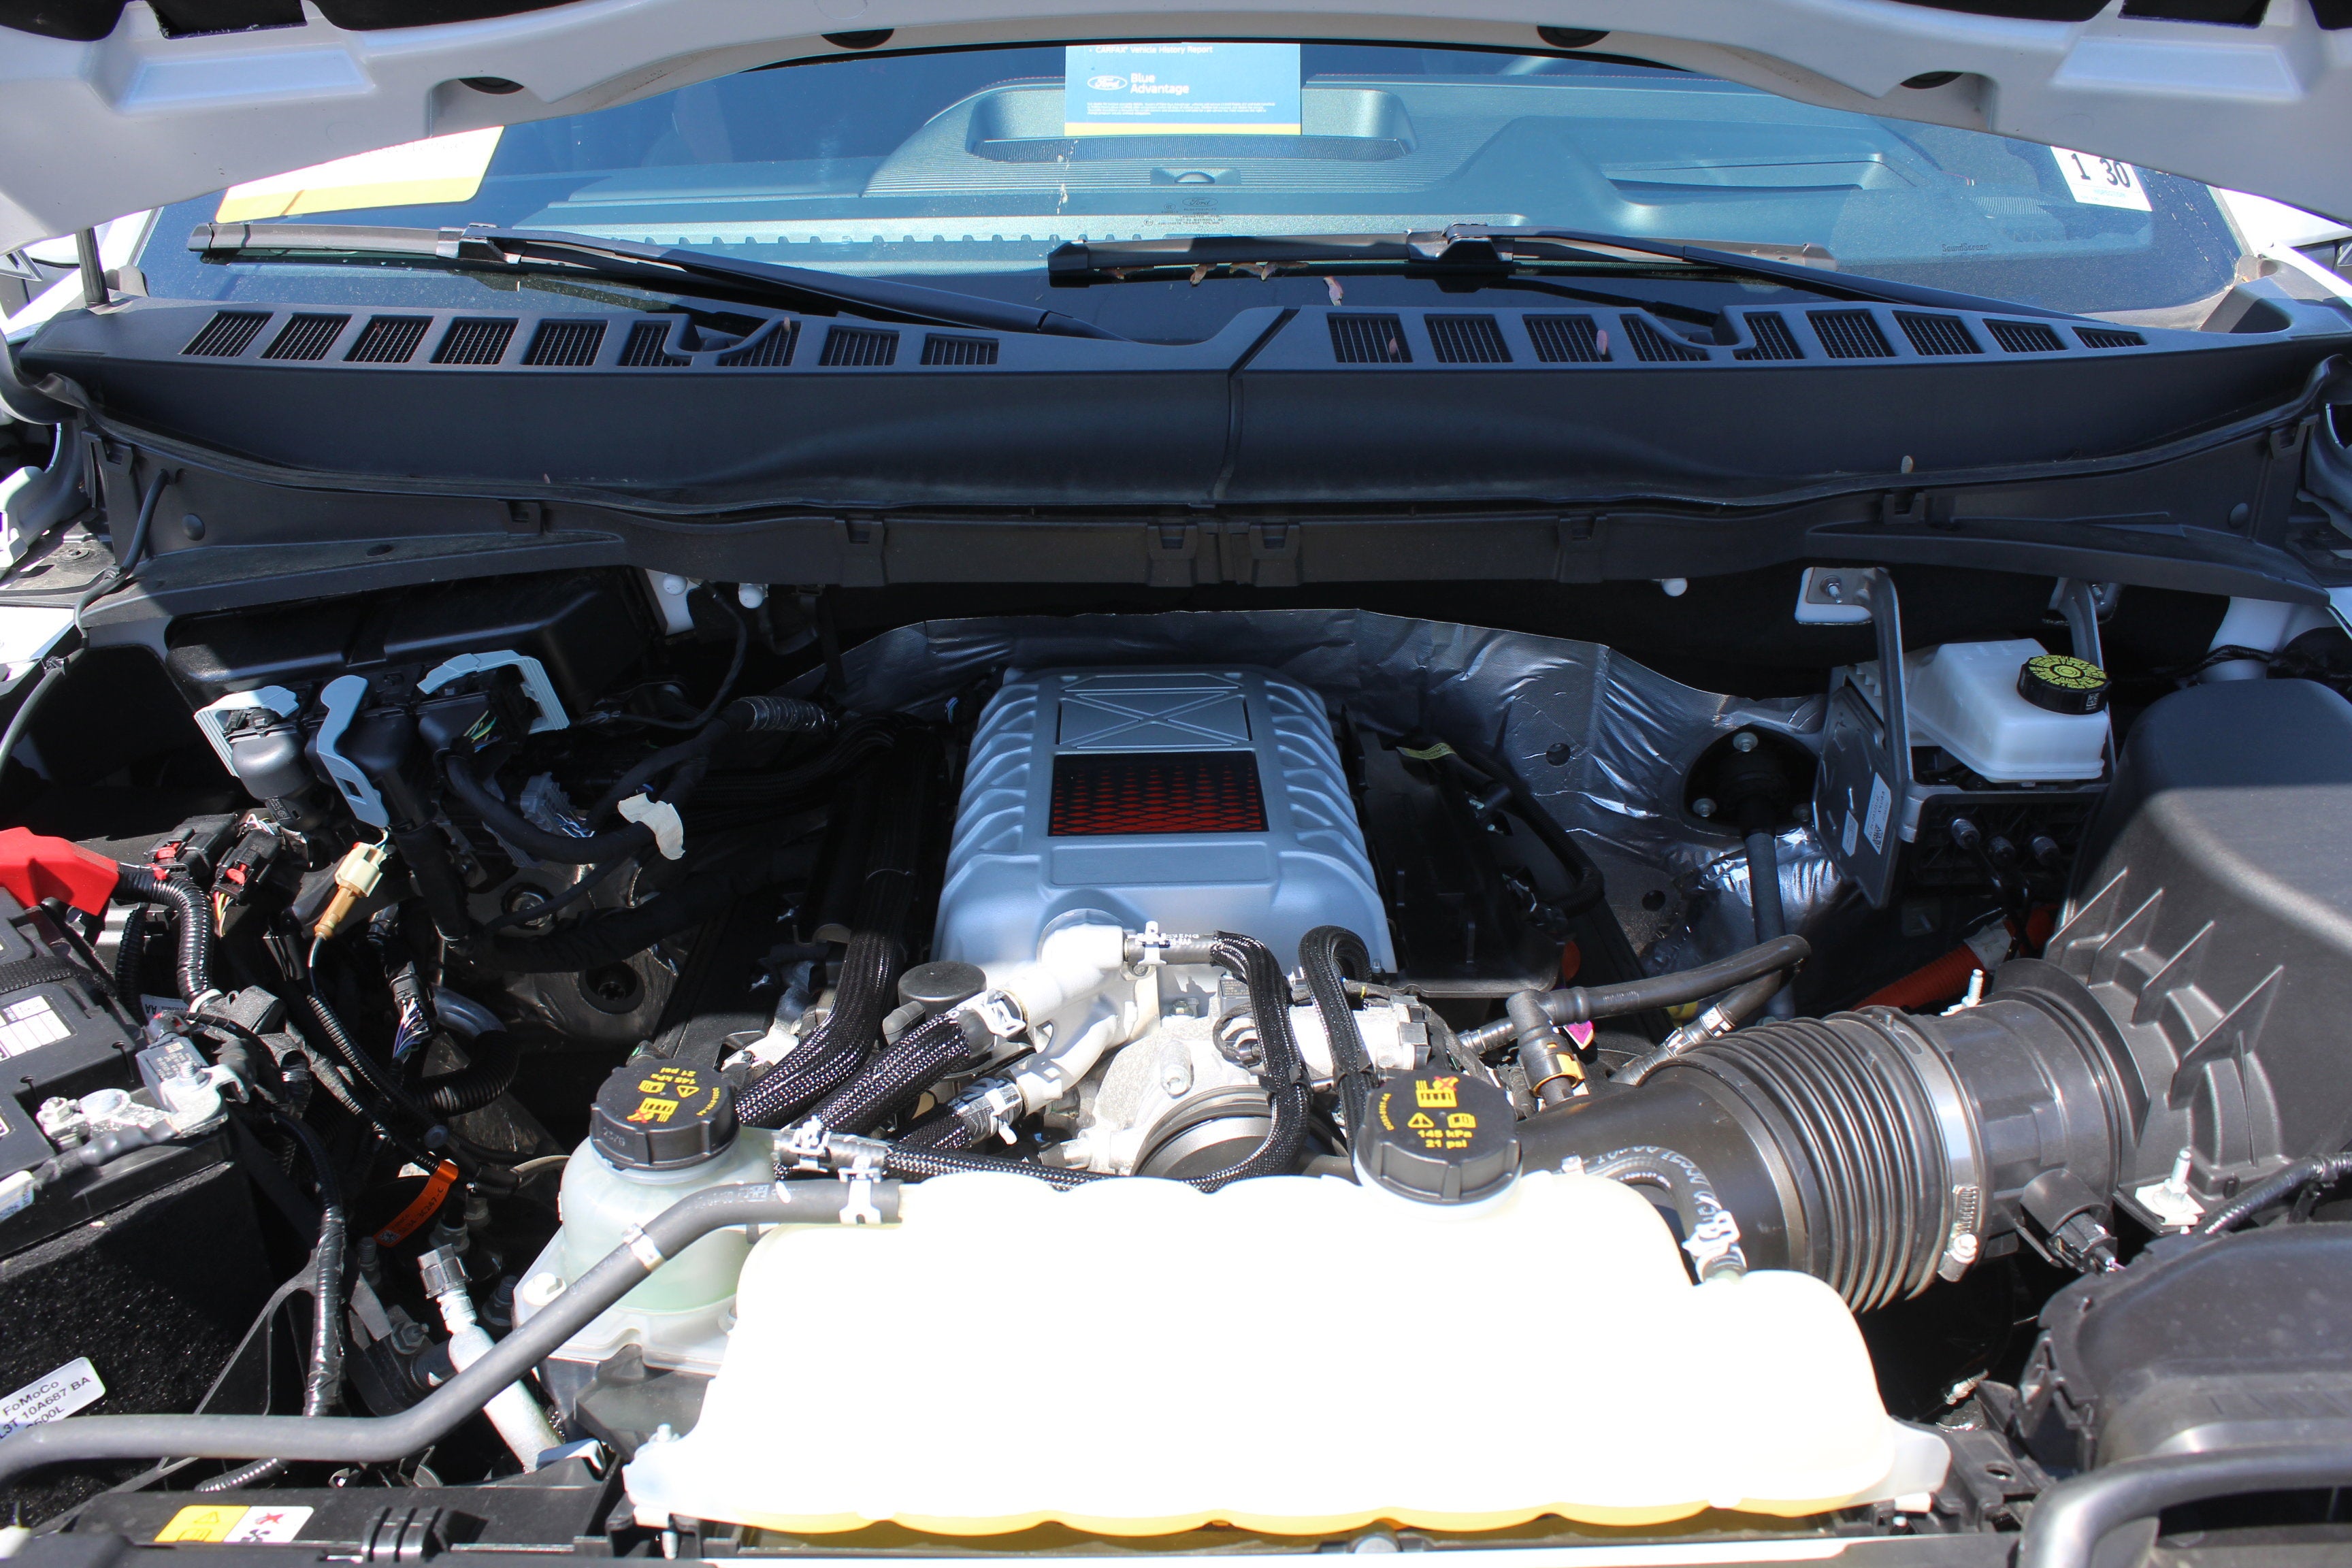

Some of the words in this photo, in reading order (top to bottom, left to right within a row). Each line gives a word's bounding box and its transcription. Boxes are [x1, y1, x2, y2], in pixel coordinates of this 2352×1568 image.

[1130, 46, 1156, 54] Vehicle
[1159, 46, 1185, 54] History
[1187, 46, 1213, 54] Report
[1130, 73, 1155, 83] Blue
[1130, 84, 1190, 95] Advantage
[2071, 153, 2091, 180] 1
[2100, 158, 2131, 189] 30
[1942, 242, 1988, 252] SoundScreen
[145, 1004, 157, 1015] AA
[650, 1073, 673, 1082] kPa
[1418, 1130, 1443, 1138] 145
[1446, 1130, 1473, 1138] kPa
[1425, 1140, 1441, 1148] 21
[1446, 1140, 1467, 1149] psi
[3, 1382, 59, 1416] FoMoCo
[22, 1388, 67, 1419] 10A687
[70, 1377, 91, 1391] BA
[25, 1405, 65, 1428] 500L
